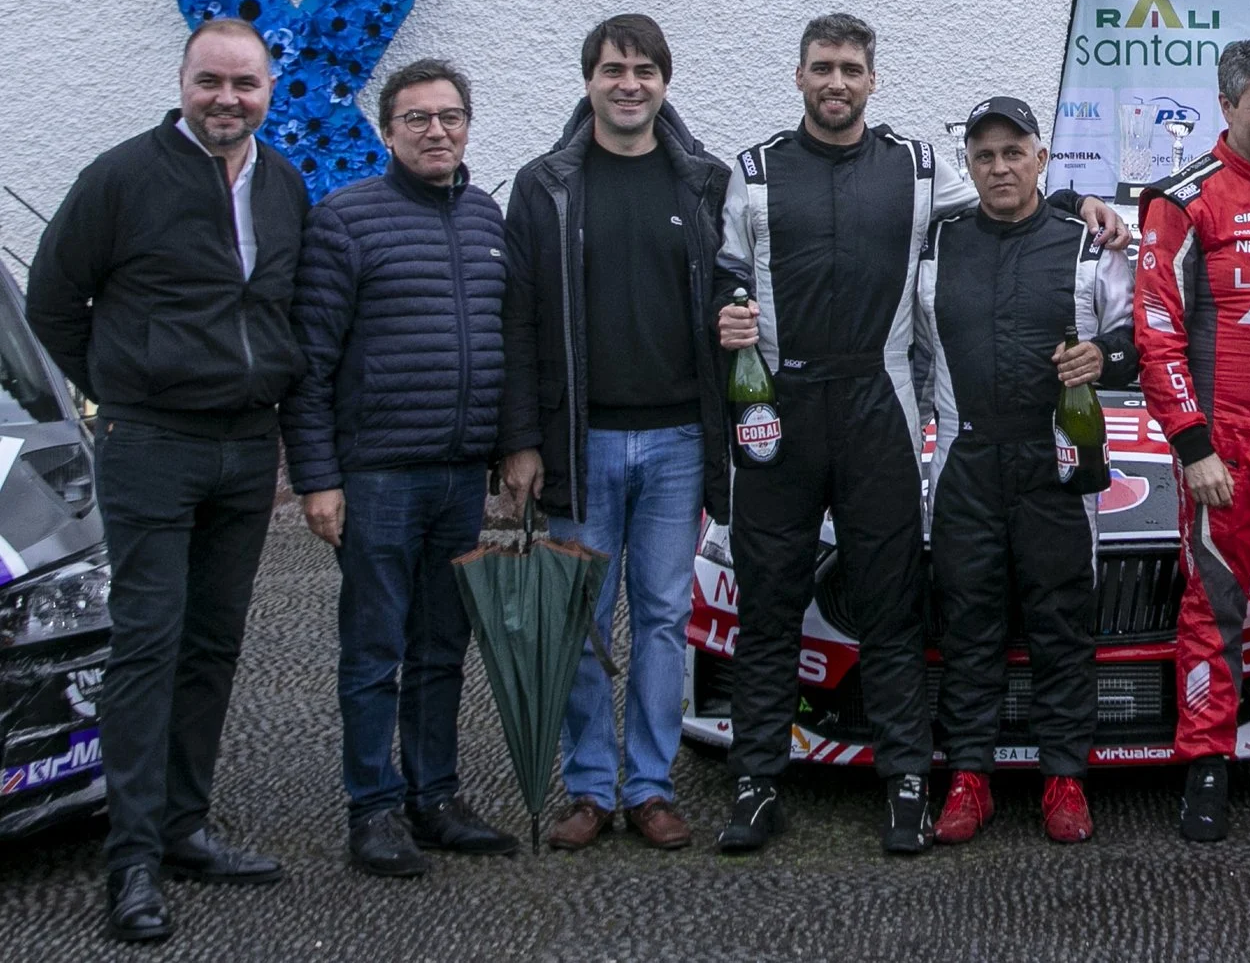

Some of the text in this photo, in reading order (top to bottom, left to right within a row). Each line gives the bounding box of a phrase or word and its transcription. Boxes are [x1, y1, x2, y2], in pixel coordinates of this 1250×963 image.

[1075, 34, 1226, 66] Santan
[1166, 361, 1198, 413] LOTE
[742, 422, 780, 441] CORAL
[1095, 747, 1175, 760] virtualcar
